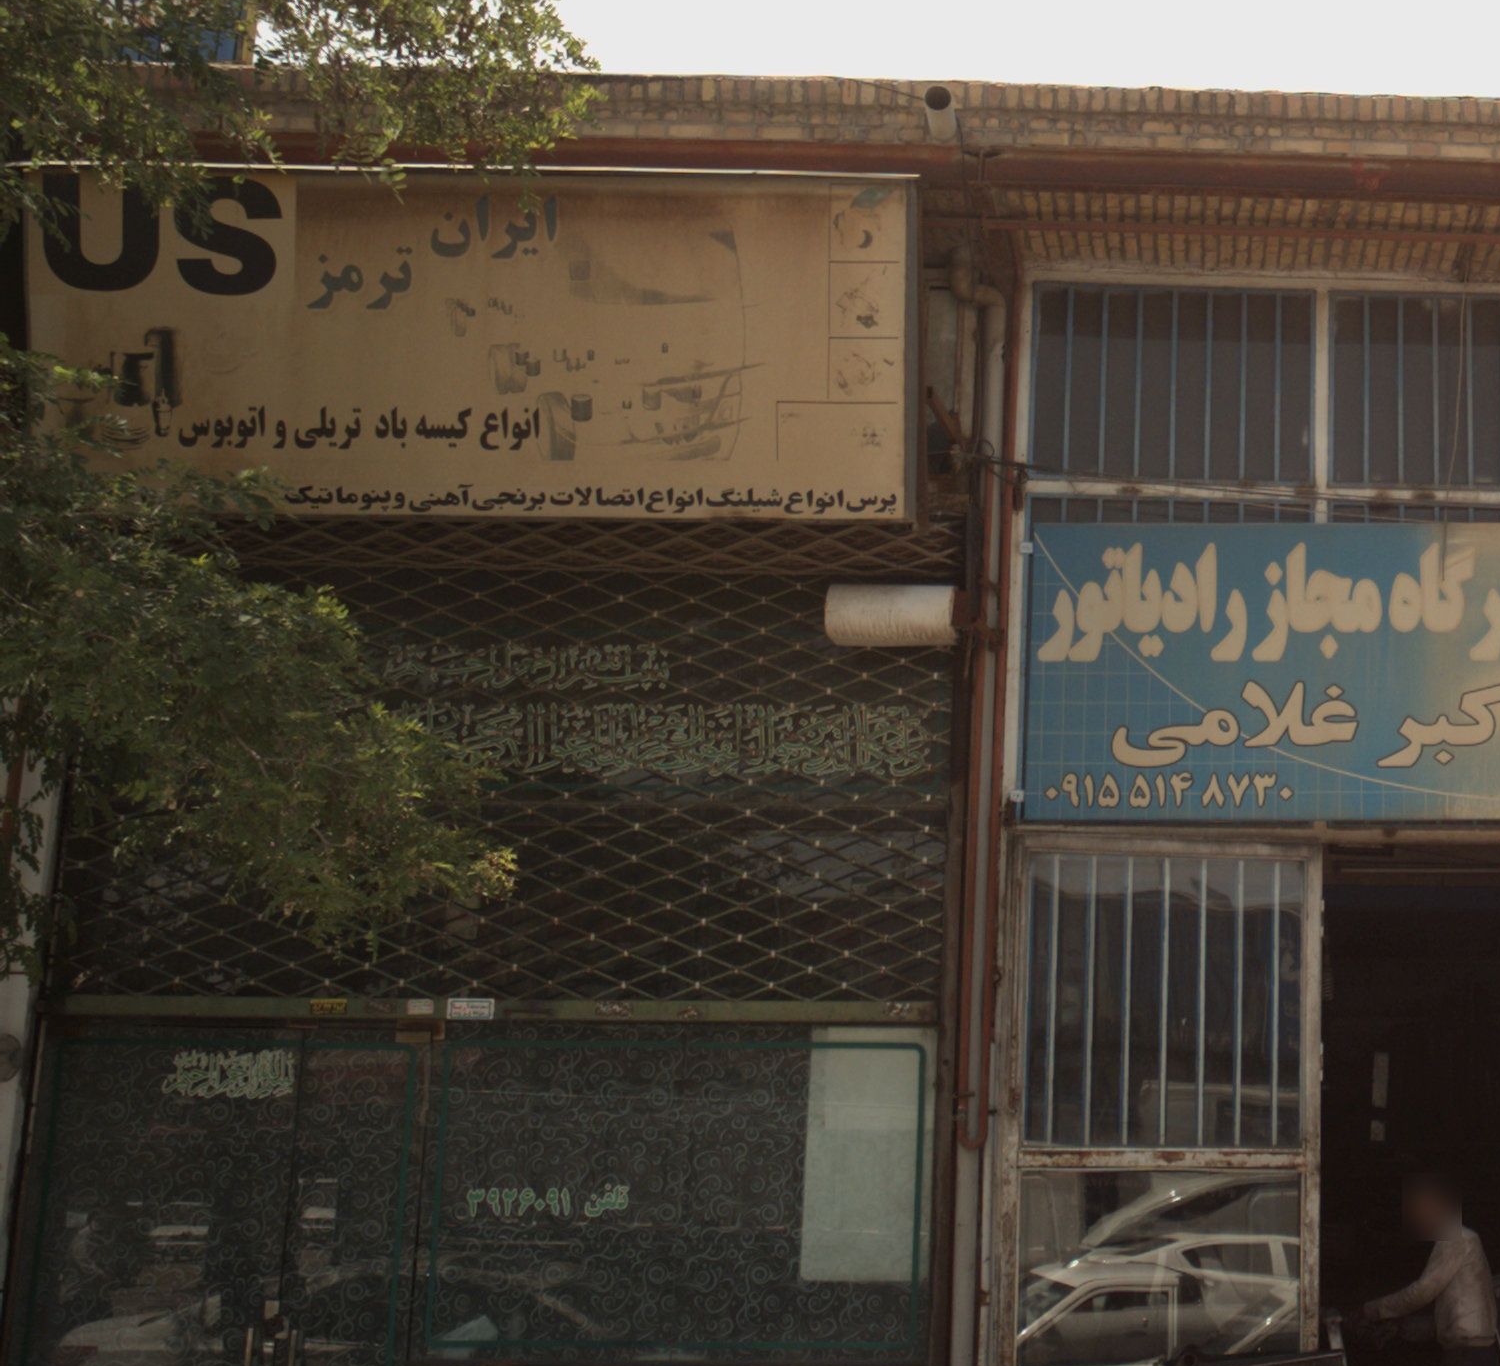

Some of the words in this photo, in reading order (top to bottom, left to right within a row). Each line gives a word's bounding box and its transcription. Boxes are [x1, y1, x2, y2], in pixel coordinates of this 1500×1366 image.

[430, 196, 557, 258] ایران
[306, 245, 412, 310] ترمز
[179, 406, 265, 448] اتوبوس
[272, 419, 286, 448] و
[294, 406, 361, 450] تریلی
[374, 406, 408, 448] باد
[415, 407, 472, 448] کیسه
[479, 406, 541, 450] انواع
[408, 484, 475, 512] آهنی
[472, 488, 546, 511] برنجی
[549, 487, 643, 508] اتصالات
[644, 487, 703, 513] انواع
[706, 487, 783, 512] شیلنگ
[784, 489, 843, 514] انواع
[846, 491, 897, 514] پرس
[1036, 541, 1249, 662] رادیاتور
[1252, 541, 1383, 662] مجاز
[1111, 680, 1360, 768] غلامی
[584, 1183, 630, 1218] تلفن
